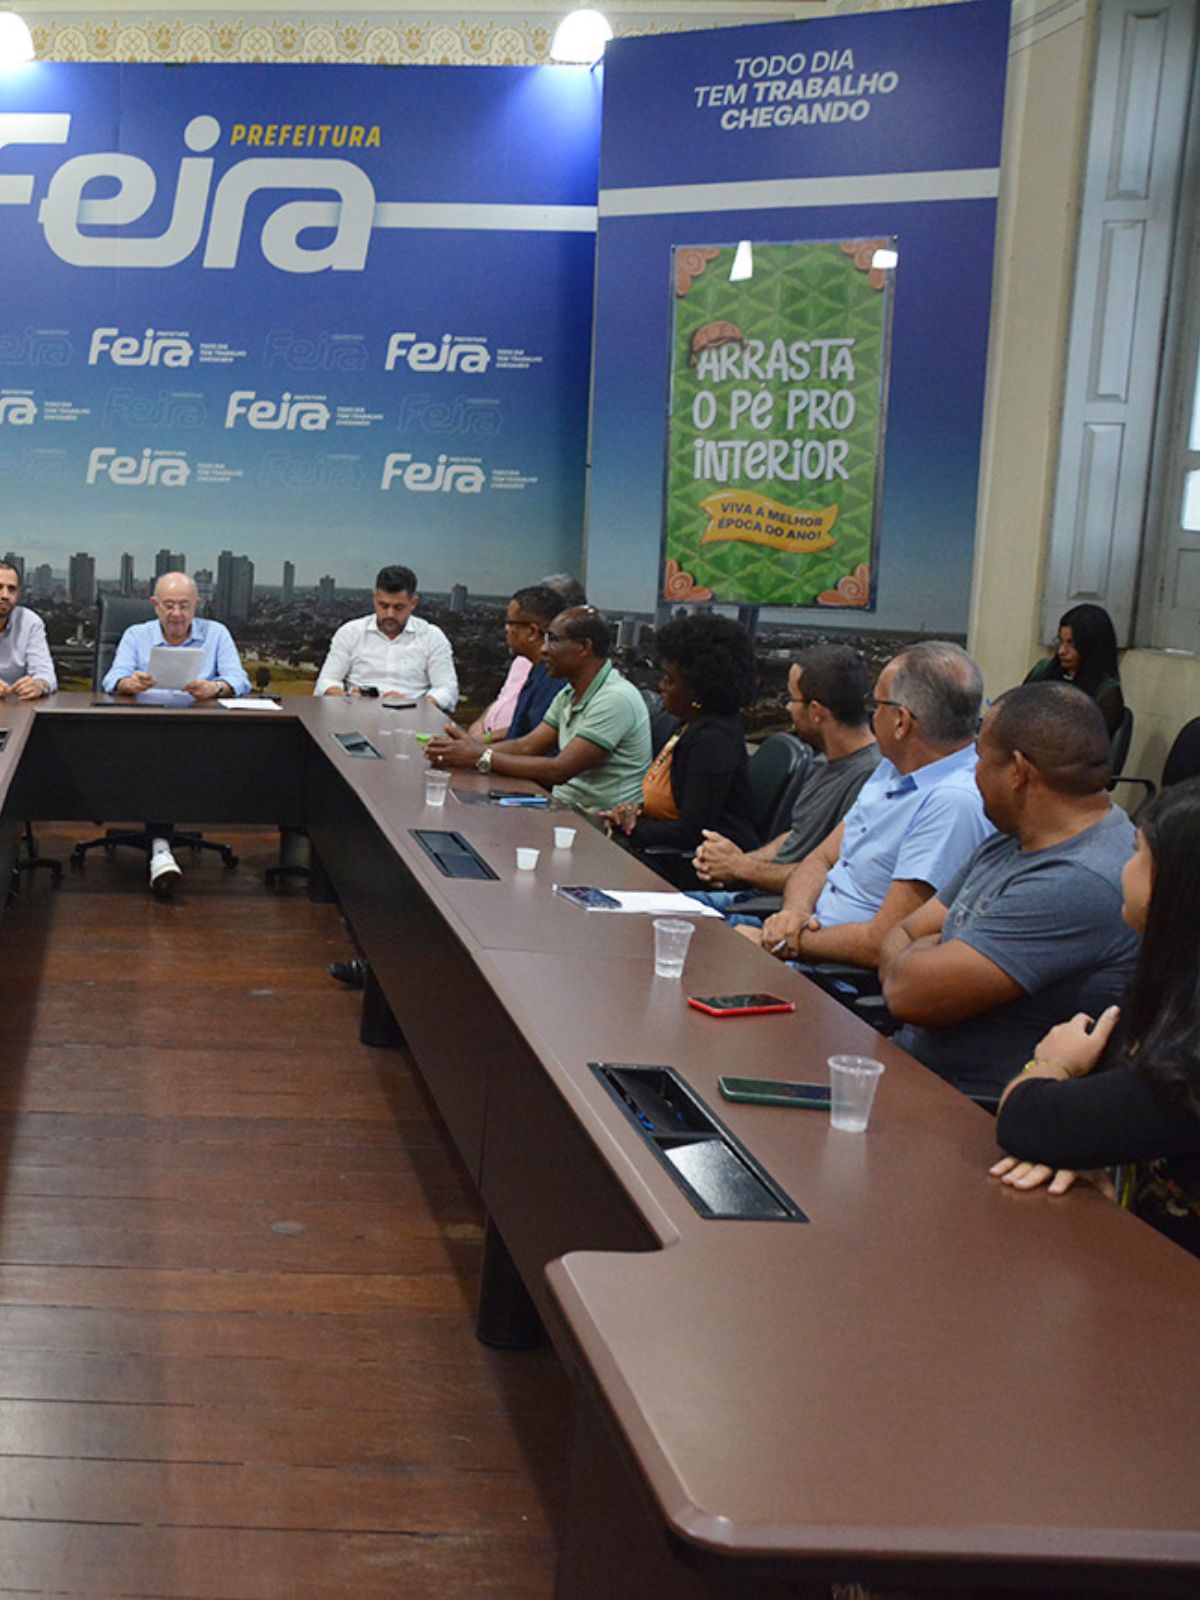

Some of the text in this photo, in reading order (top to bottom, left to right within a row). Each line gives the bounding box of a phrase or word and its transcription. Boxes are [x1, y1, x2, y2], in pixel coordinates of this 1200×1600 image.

[735, 48, 855, 79] TODO DIA
[694, 71, 898, 108] TEM TRABALHO
[720, 99, 870, 130] CHEGANDO
[230, 123, 382, 148] PREFEITURA
[696, 338, 856, 382] ARRASTA
[692, 390, 717, 430] O
[786, 389, 857, 430] PRO
[721, 502, 823, 527] VIVA A MELHOR
[765, 523, 785, 537] DO
[786, 529, 822, 541] ANO!
